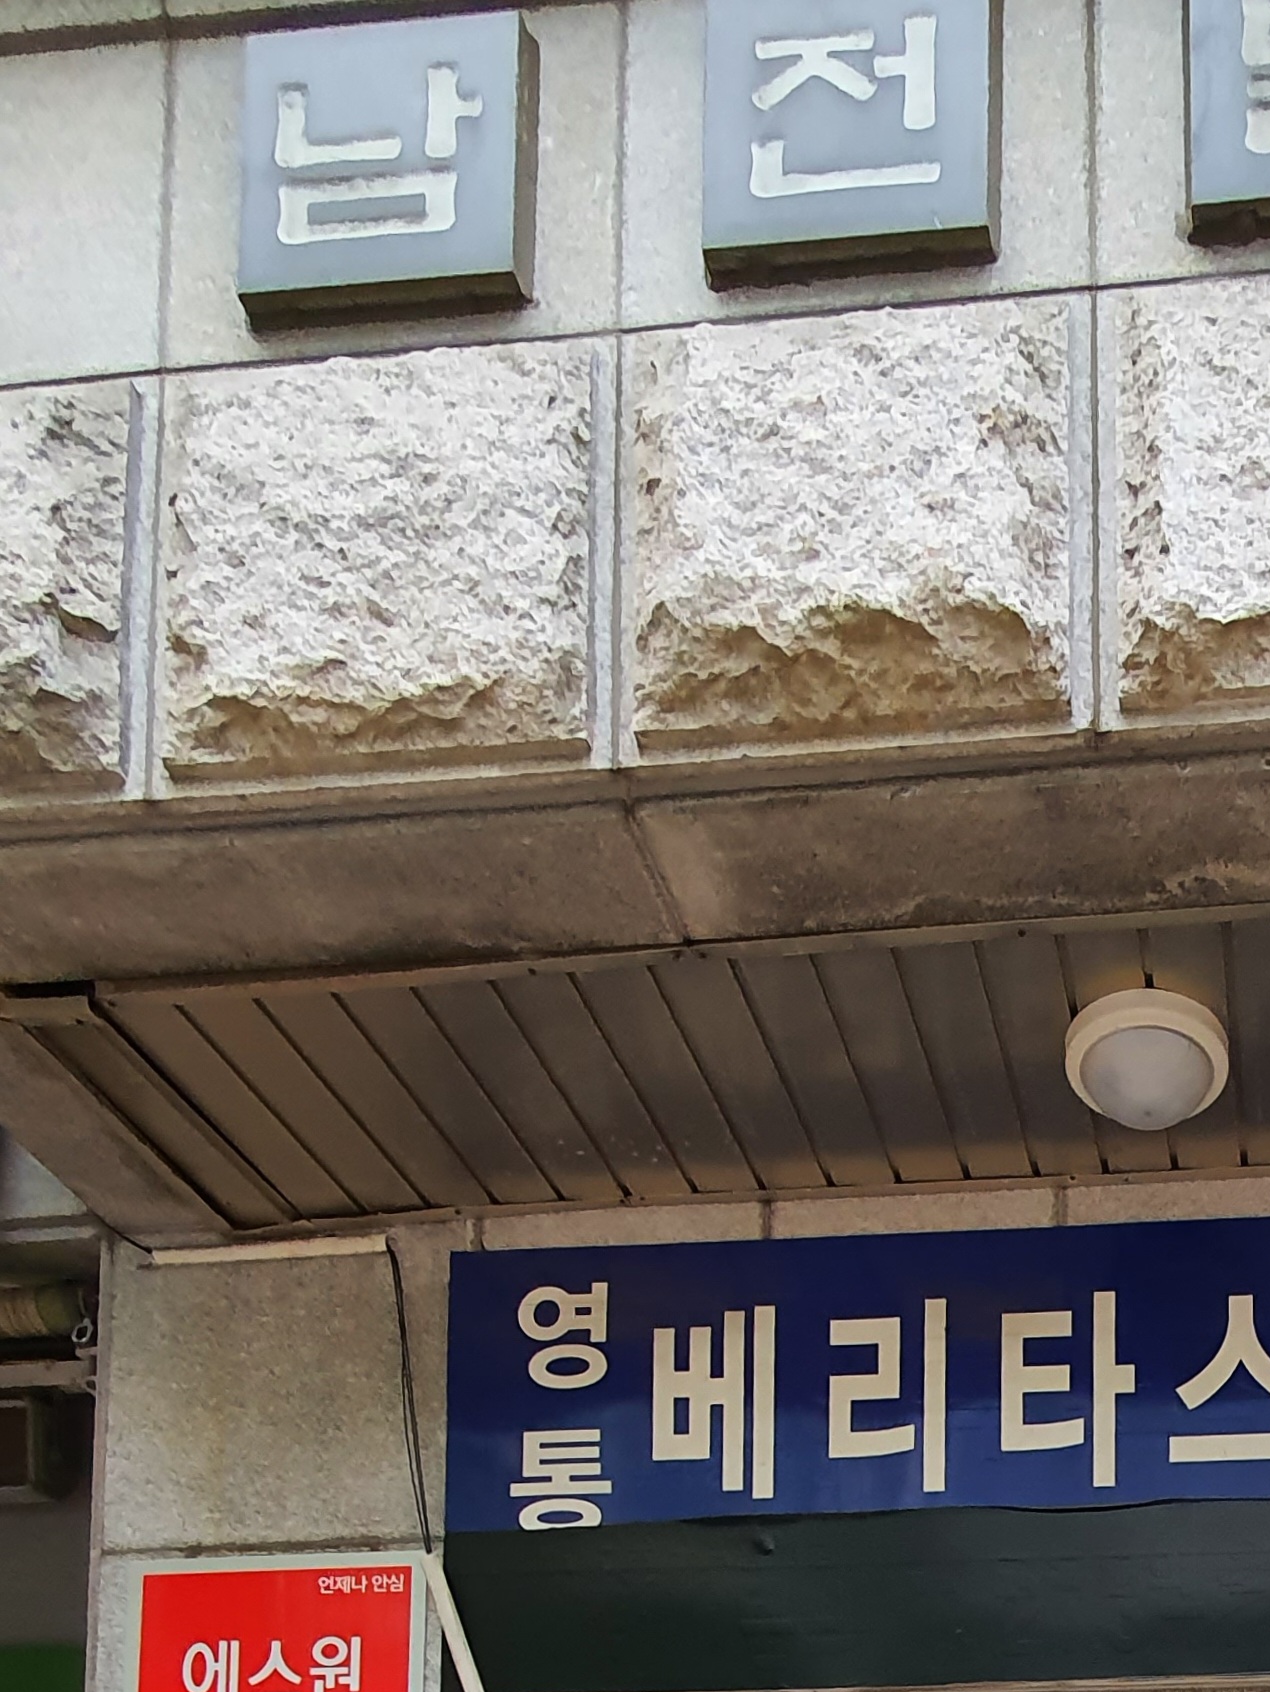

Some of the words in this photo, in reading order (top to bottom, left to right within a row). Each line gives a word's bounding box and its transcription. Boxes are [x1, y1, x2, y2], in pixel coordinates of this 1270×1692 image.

[509, 1282, 612, 1530] 영통
[317, 1574, 367, 1594] 언제나
[371, 1573, 404, 1592] 안심
